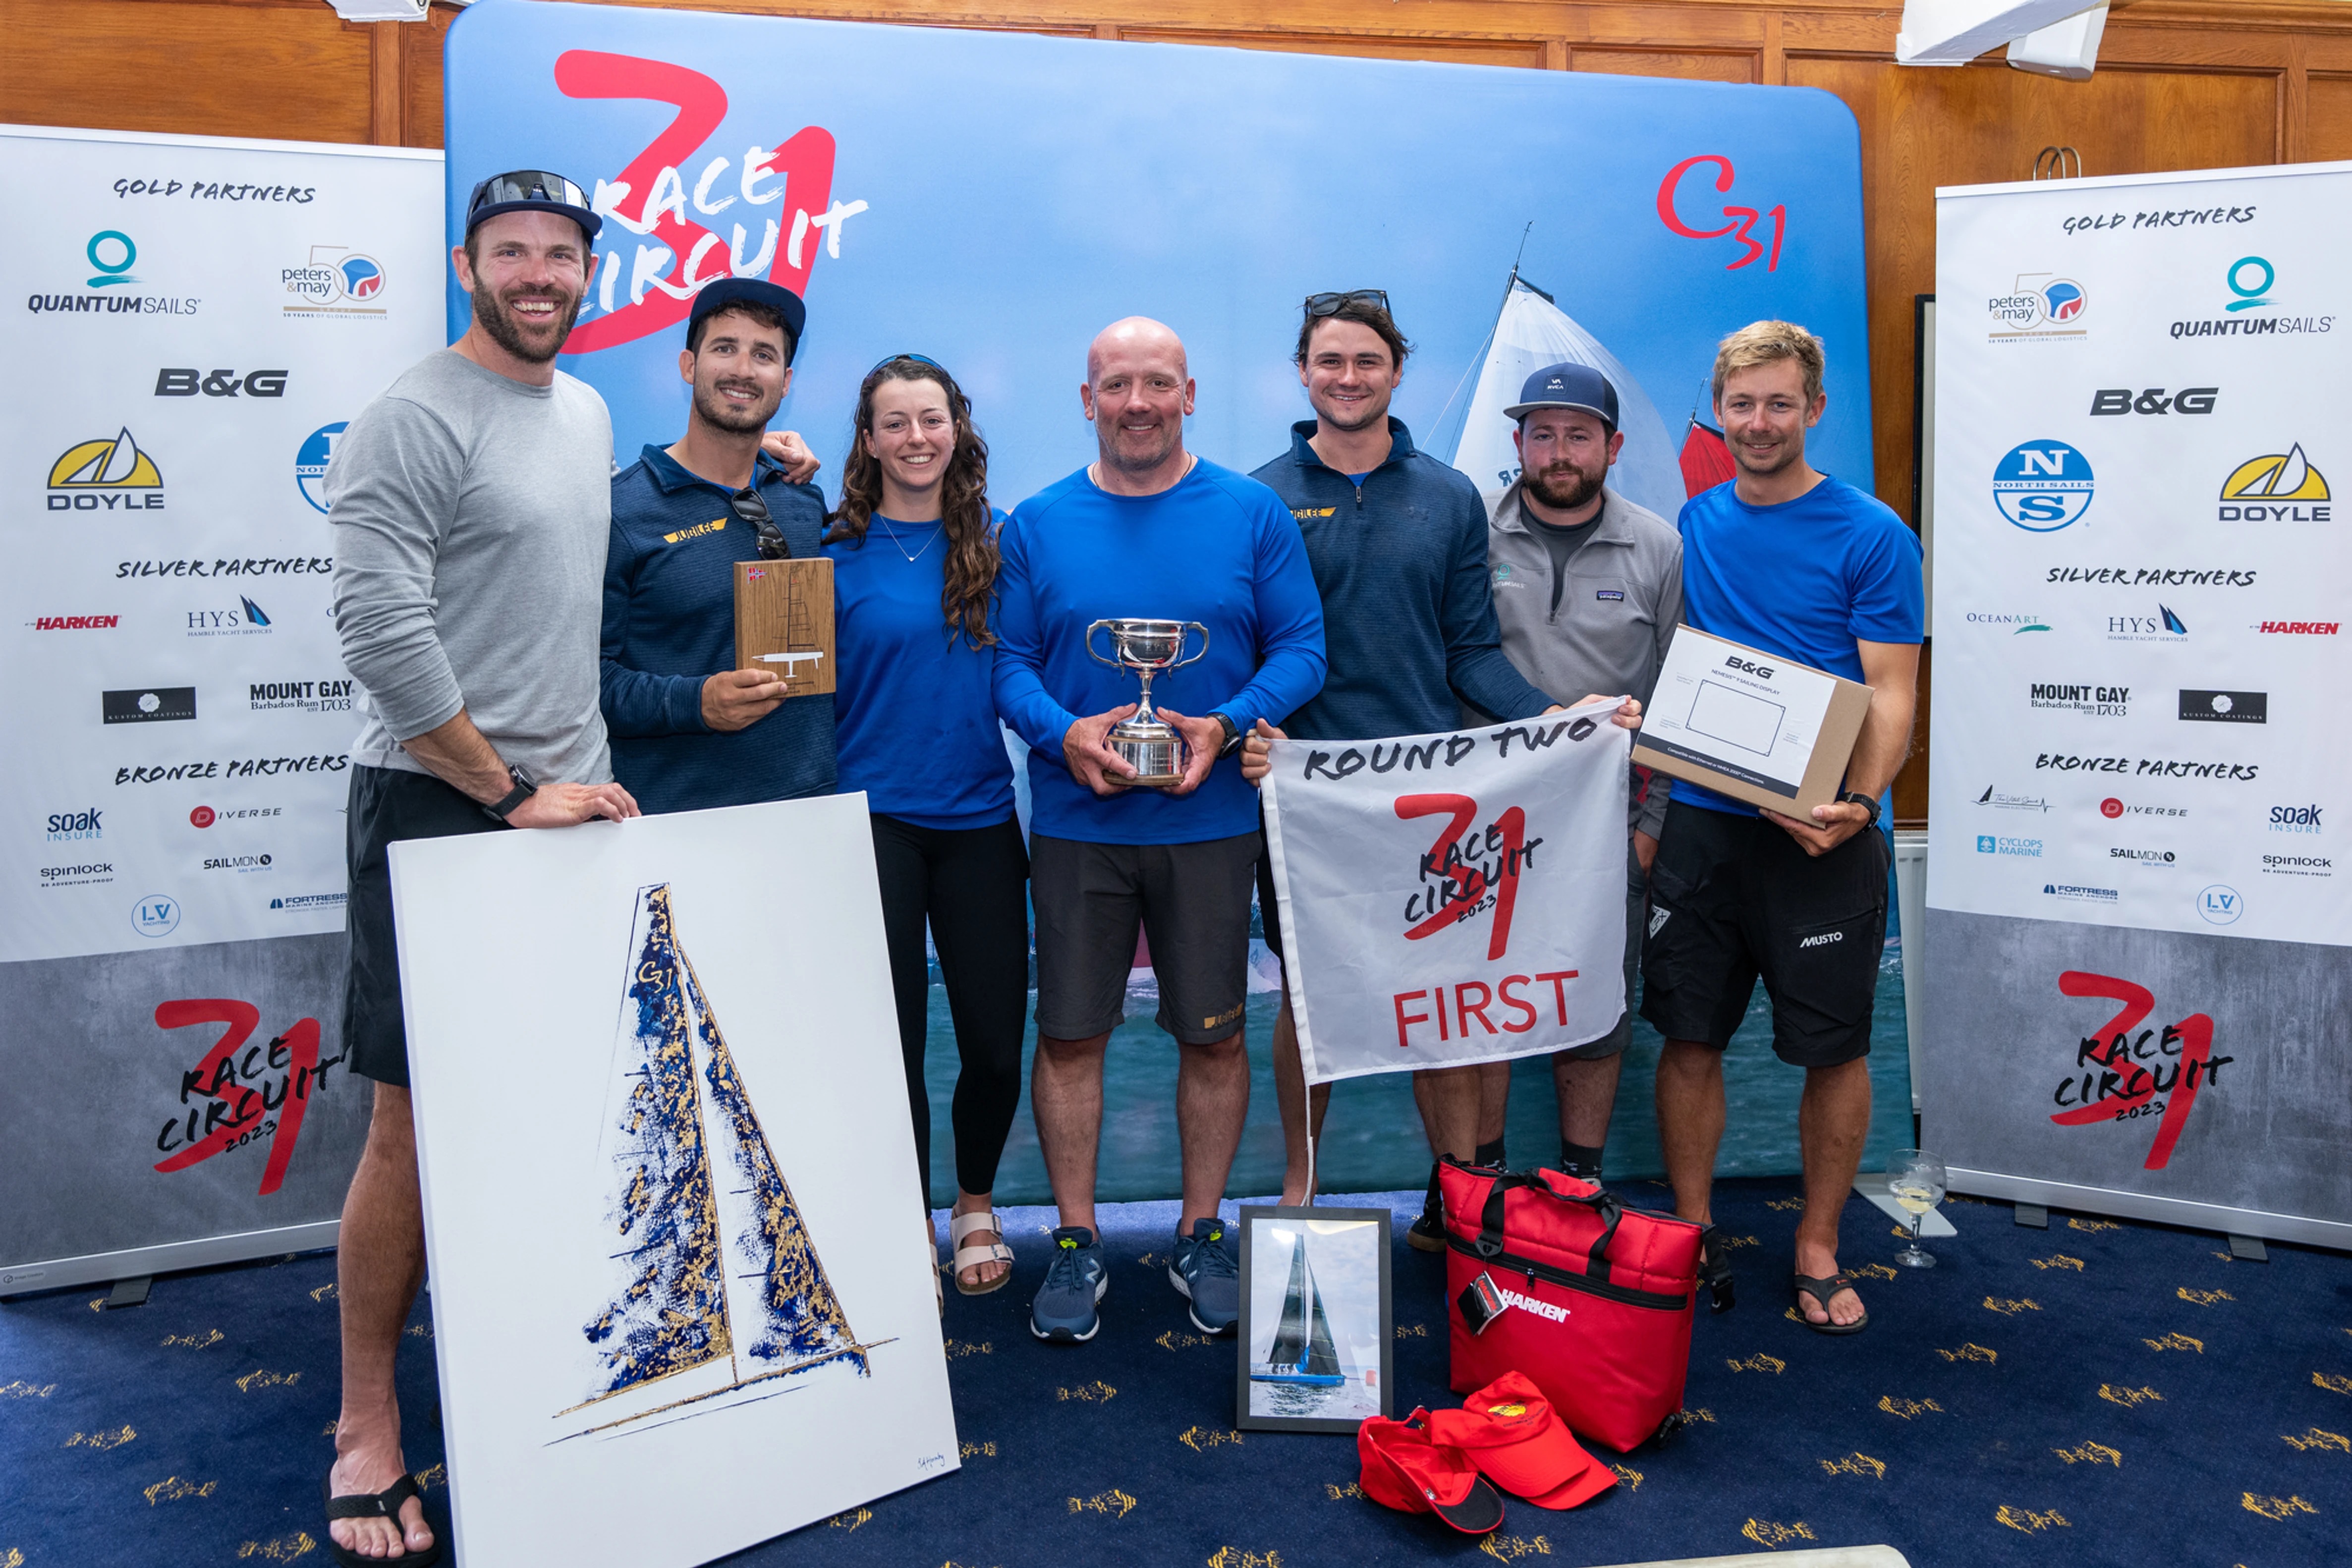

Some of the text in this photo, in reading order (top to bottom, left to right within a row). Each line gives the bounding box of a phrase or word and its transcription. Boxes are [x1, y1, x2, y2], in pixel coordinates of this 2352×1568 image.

[114, 178, 316, 203] GOLD PARTNERS
[593, 147, 784, 240] RACE
[555, 50, 836, 354] 31
[1656, 155, 1786, 273] C31
[2063, 206, 2256, 235] GOLD PARTNERS
[578, 200, 869, 318] IRCUIT
[282, 268, 331, 282] peters
[287, 281, 331, 297] &may
[1989, 296, 2034, 311] peters
[1993, 309, 2034, 322] &may
[154, 368, 288, 397] B&G
[2090, 388, 2219, 416] B&G
[2018, 449, 2069, 475] N
[47, 494, 164, 510] DOYLE
[2018, 496, 2066, 521] S
[2219, 506, 2330, 521] DOYLE
[115, 557, 333, 578] SILVER PARTNERS
[2047, 567, 2256, 587] SILVER PARTNERS
[36, 616, 118, 630] HARKEN
[187, 611, 239, 628] HYS
[2108, 617, 2156, 633] HYS
[2259, 621, 2339, 634] HARKEN
[1725, 656, 1774, 679] B&G
[250, 680, 352, 700] MOUNT GAY
[1740, 679, 1759, 689] SAILING
[1759, 685, 1780, 695] DISPLAY
[2031, 684, 2129, 703] MOUNT GAY
[251, 700, 294, 710] Barbados
[321, 699, 351, 712] 1703
[2031, 700, 2095, 711] Barbados Rum
[2097, 704, 2126, 716] 1703
[1304, 719, 1597, 781] ROUND TWO
[114, 755, 349, 786] BRONZE PARTNERS
[2035, 753, 2258, 781] BRONZE PARTNERS
[47, 807, 103, 833] soak
[2270, 804, 2323, 826] soak
[47, 830, 102, 841] INSURE
[2269, 824, 2321, 834] INSURE
[1420, 824, 1503, 883] RACE
[1999, 838, 2043, 848] CYCLOPS
[1999, 847, 2042, 857] MARINE
[41, 863, 113, 880] spinlock
[2263, 855, 2332, 867] spinlock
[52, 878, 113, 887] ADVENTURE-PROOF
[1394, 793, 1525, 961] 31
[1404, 838, 1543, 922] CIRCUIT
[285, 893, 347, 904] FORTRESS
[2058, 886, 2118, 896] FORTRESS
[1457, 895, 1496, 923] 2023
[1800, 932, 1843, 948] MUSTO
[1394, 969, 1578, 1047] FIRST
[2077, 1025, 2184, 1067] RACE
[181, 1037, 292, 1104] RACE
[2049, 970, 2214, 1170] 31
[2054, 1056, 2234, 1106] CIRCUIT
[154, 999, 320, 1195] 31
[157, 1056, 340, 1152] CIRCUIT
[2116, 1101, 2166, 1121] 2023
[224, 1120, 277, 1153] 2023
[1501, 1288, 1567, 1323] HARKEN
